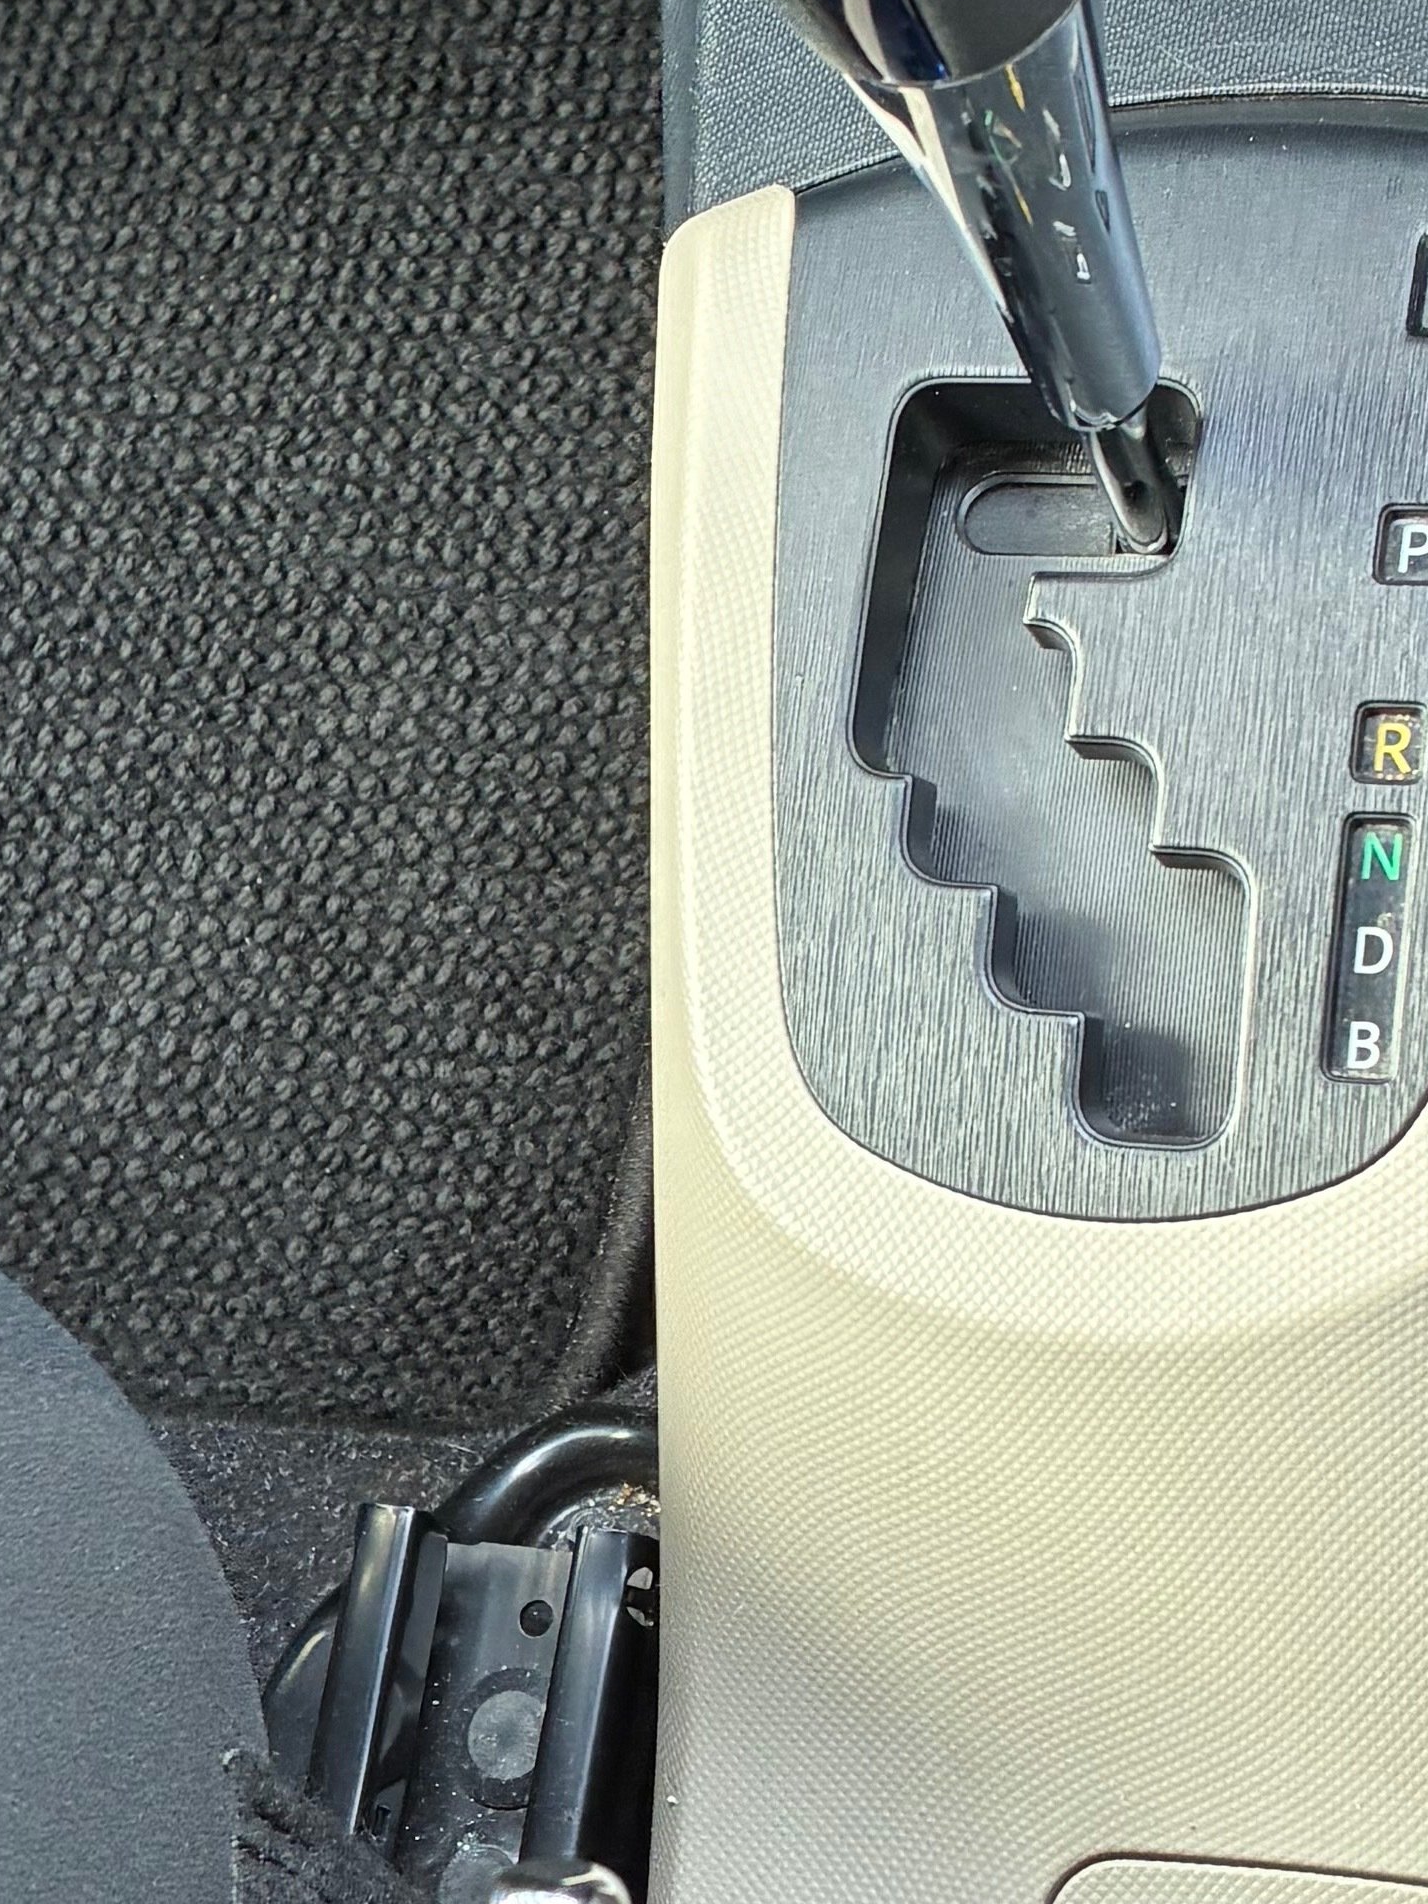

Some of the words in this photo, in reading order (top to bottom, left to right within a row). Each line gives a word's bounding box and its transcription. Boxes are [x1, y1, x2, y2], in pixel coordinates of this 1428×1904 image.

[1373, 723, 1412, 774] R
[1361, 833, 1404, 881] N
[1353, 926, 1395, 975] D
[1346, 1021, 1382, 1070] B
